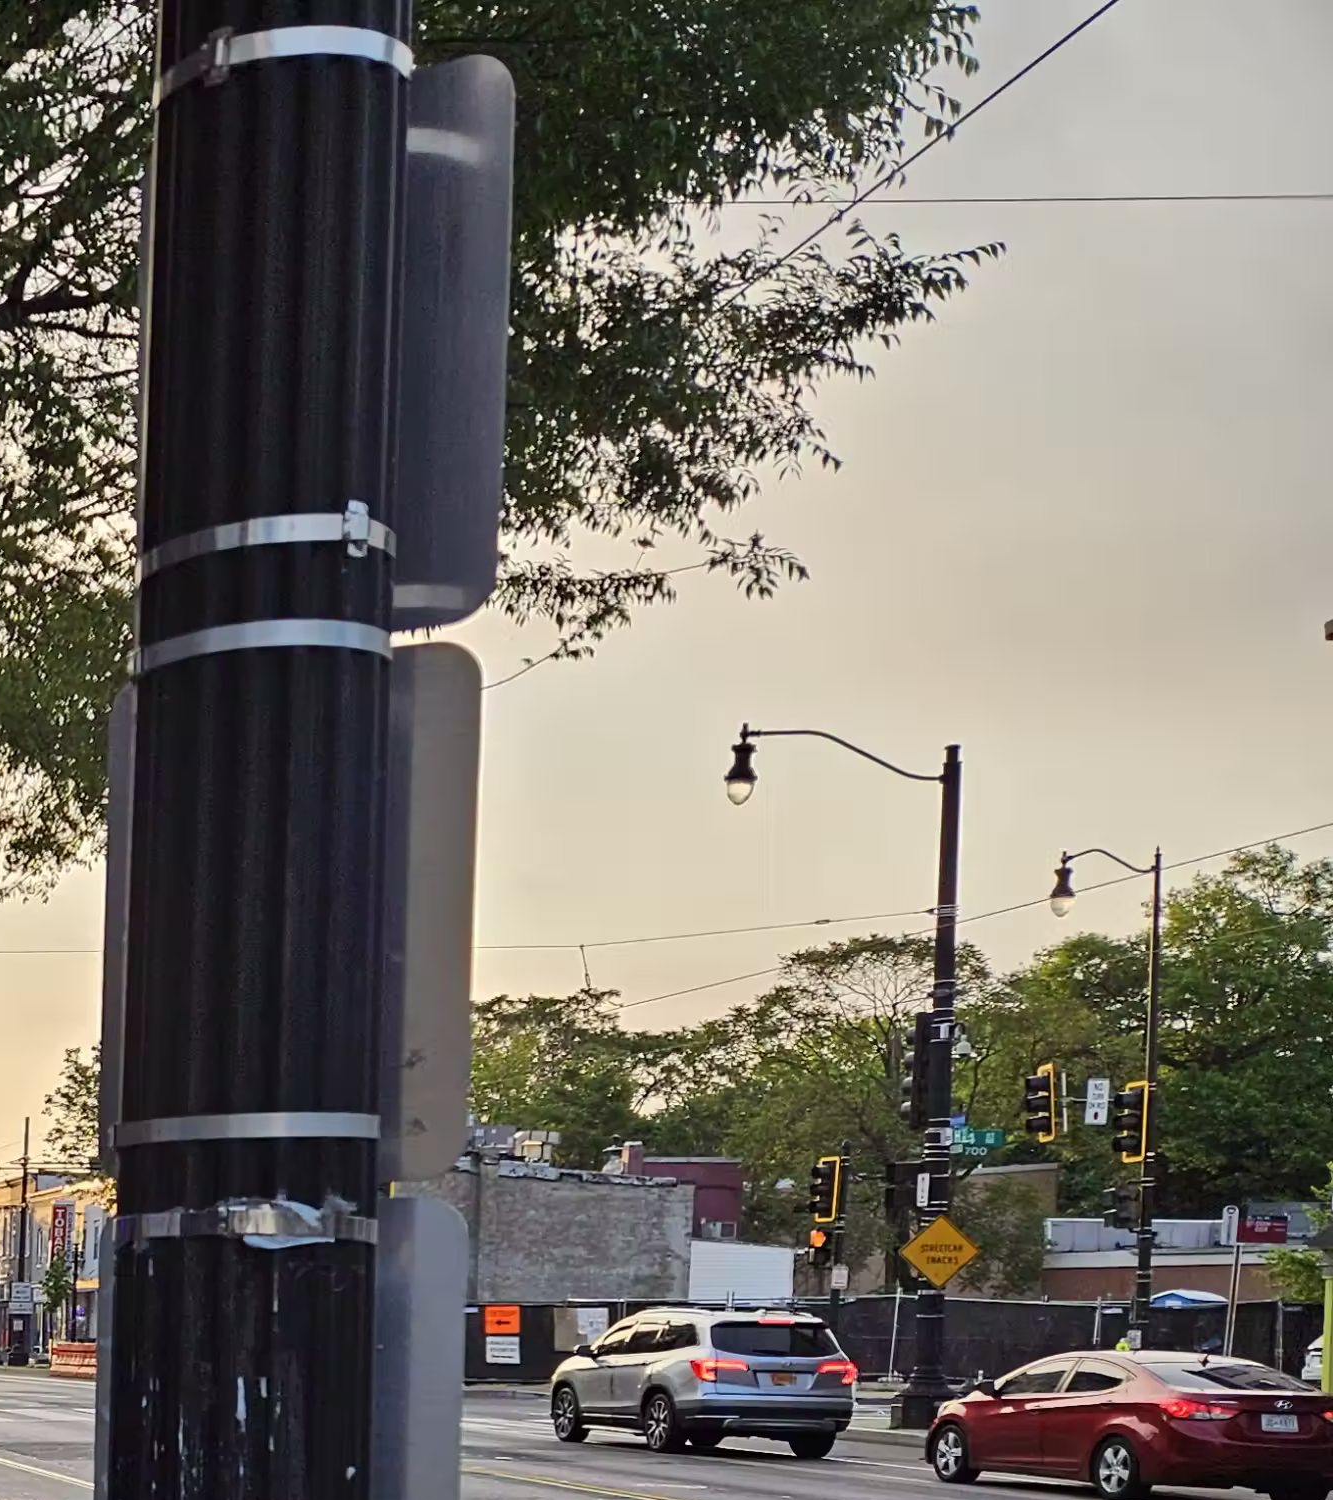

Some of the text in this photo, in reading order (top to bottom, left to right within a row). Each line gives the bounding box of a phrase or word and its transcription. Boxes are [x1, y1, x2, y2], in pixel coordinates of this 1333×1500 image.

[965, 1147, 987, 1155] 700
[920, 1244, 963, 1253] STREETCAR
[927, 1256, 958, 1265] TRACKS
